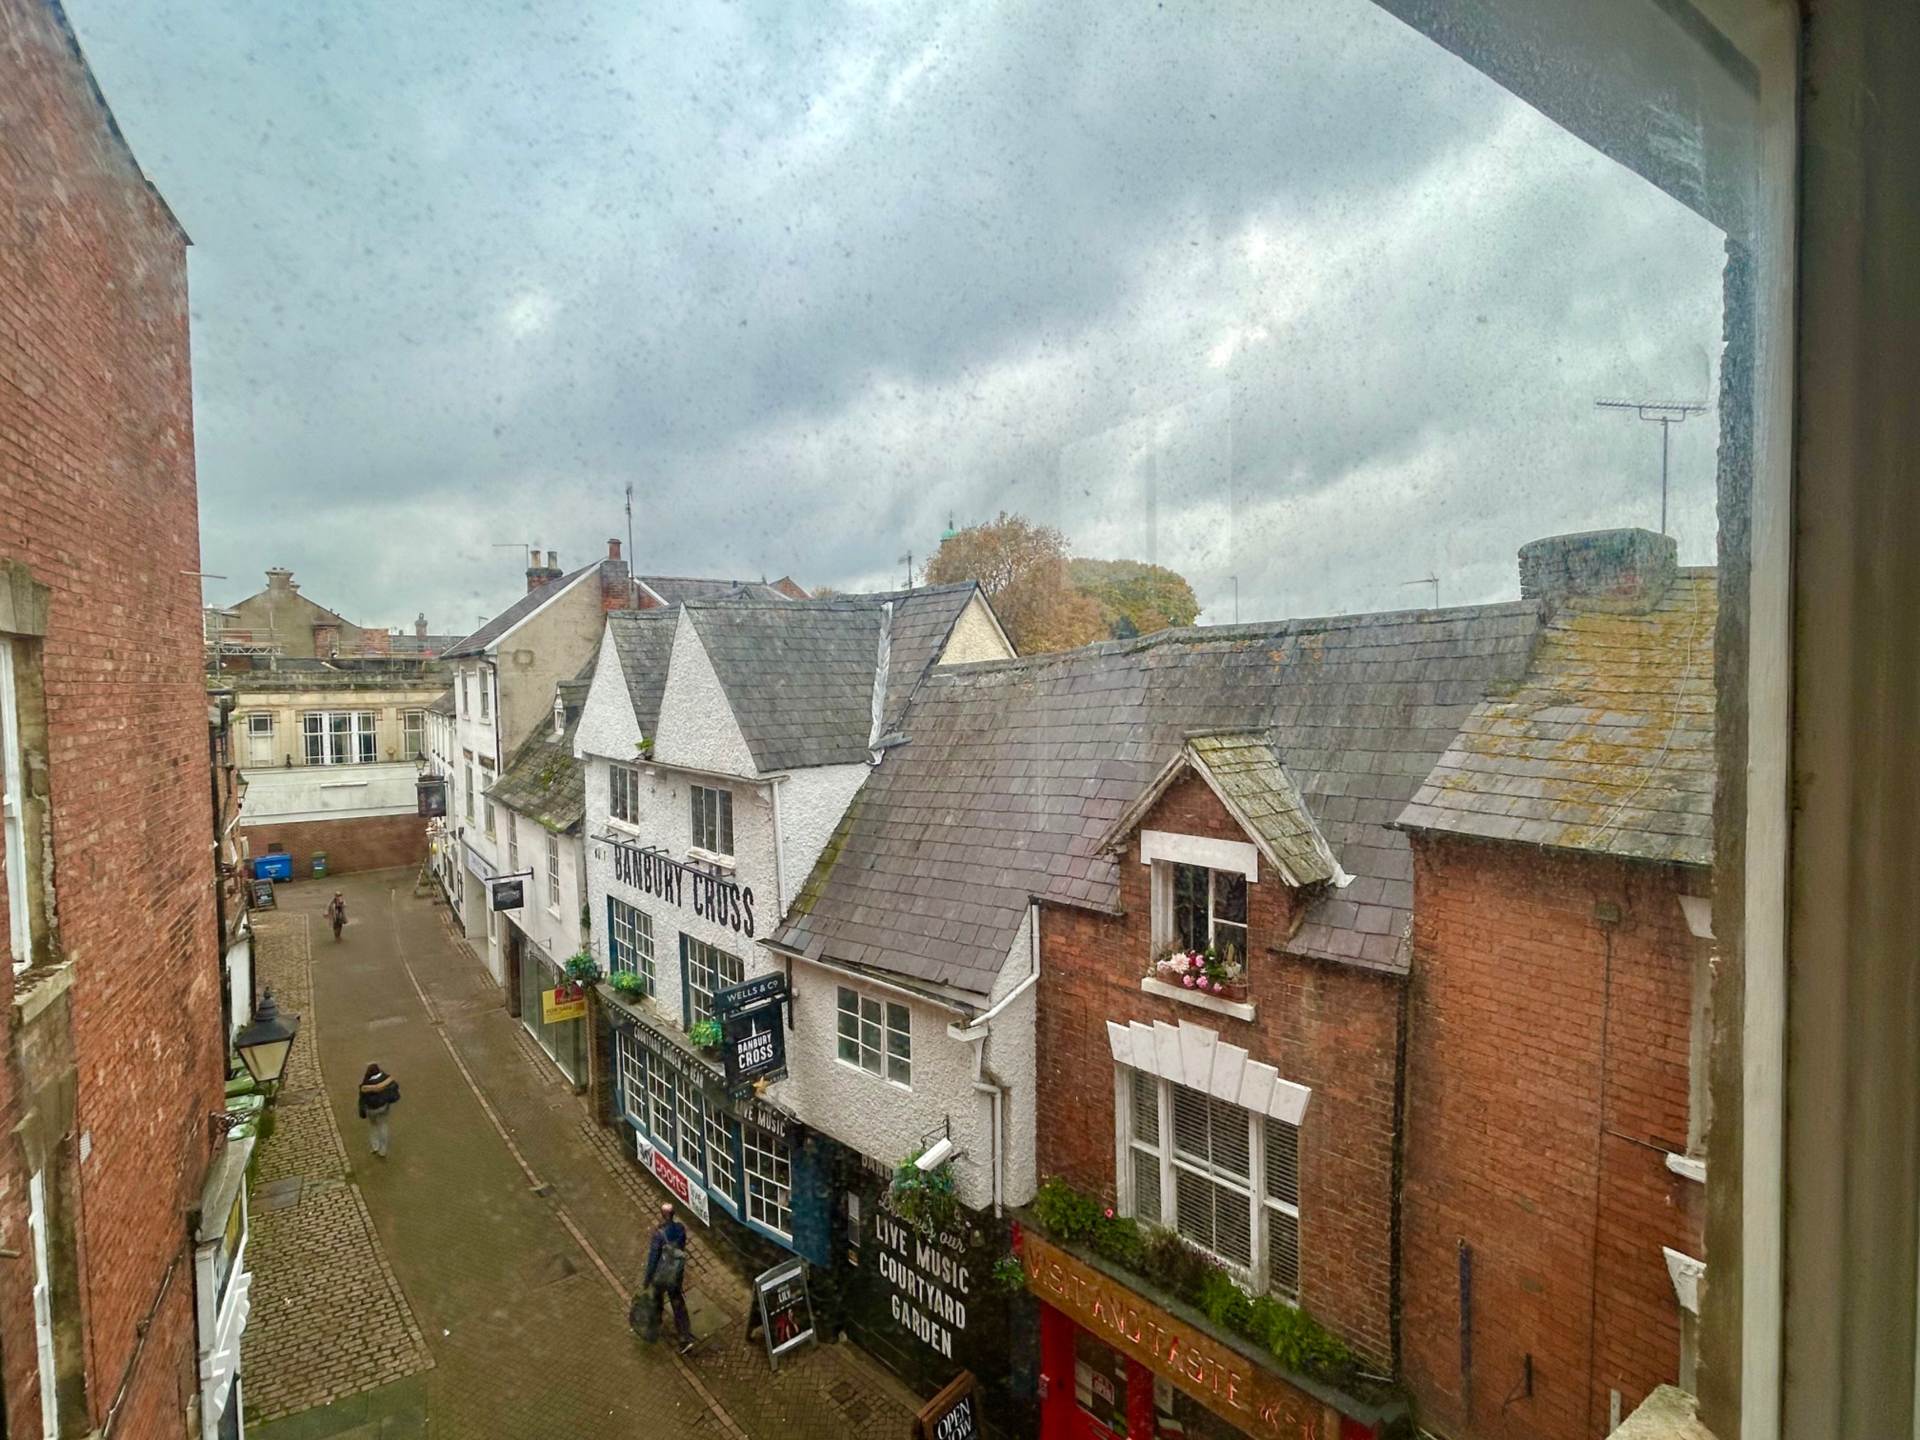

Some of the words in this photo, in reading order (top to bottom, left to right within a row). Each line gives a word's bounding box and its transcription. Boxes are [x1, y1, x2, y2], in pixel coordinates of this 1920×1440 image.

[614, 844, 683, 908] BANBURY
[693, 870, 754, 938] CROSS
[727, 986, 758, 1002] WELLS
[759, 984, 766, 993] &
[737, 1032, 772, 1055] BANBURY
[738, 1043, 774, 1069] CROSS
[757, 1110, 786, 1138] MUSIC
[876, 1214, 908, 1257] LIVE
[916, 1239, 970, 1295] MUSIC
[939, 1231, 967, 1254] our
[879, 1251, 966, 1330] COURTYARD
[891, 1293, 952, 1359] GARDEN
[1092, 1288, 1142, 1344] AND
[1146, 1321, 1243, 1410] TASTE
[937, 1397, 971, 1440] OPEN
